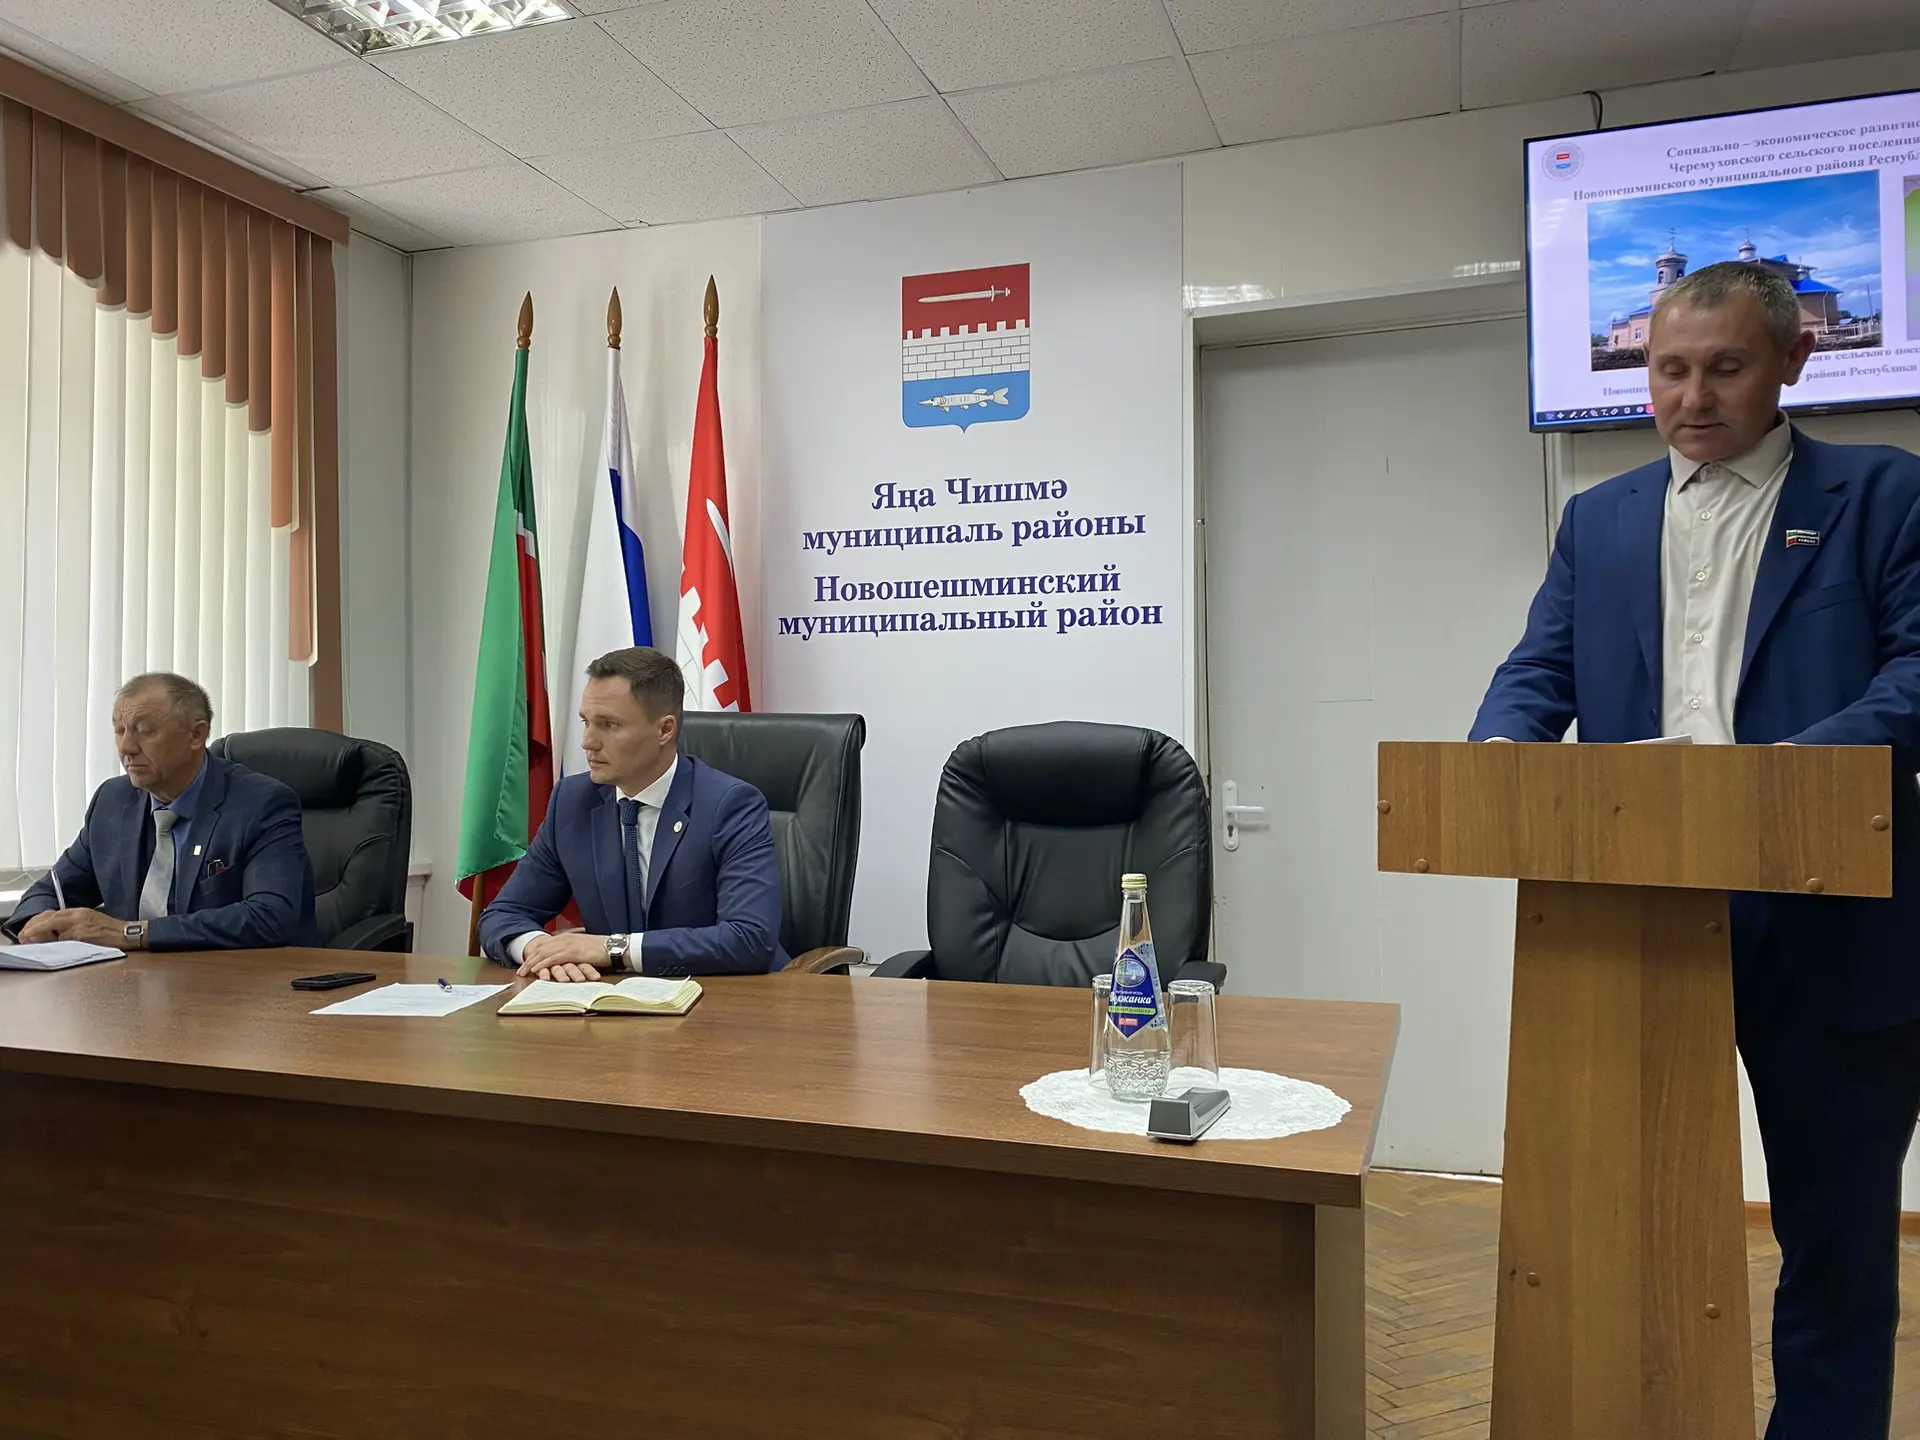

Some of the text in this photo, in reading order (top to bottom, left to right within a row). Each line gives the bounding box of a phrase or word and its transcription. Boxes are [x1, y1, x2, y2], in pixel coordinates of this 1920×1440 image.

[1666, 142, 1740, 158] Социально
[1754, 128, 1857, 147] экономическое
[1669, 152, 1775, 174] Черемуховского
[1778, 145, 1845, 160] сельского
[1573, 179, 1696, 201] Новошешминского
[1698, 165, 1813, 187] муниципального
[1816, 158, 1865, 174] района
[1834, 349, 1892, 360] сельского
[1806, 363, 1918, 382] района Республики
[871, 478, 1068, 512] Яңа Чишмә
[802, 510, 1146, 556] муниципаль районы
[814, 564, 1121, 602] Новошешминский
[778, 598, 1163, 641] муниципальный район
